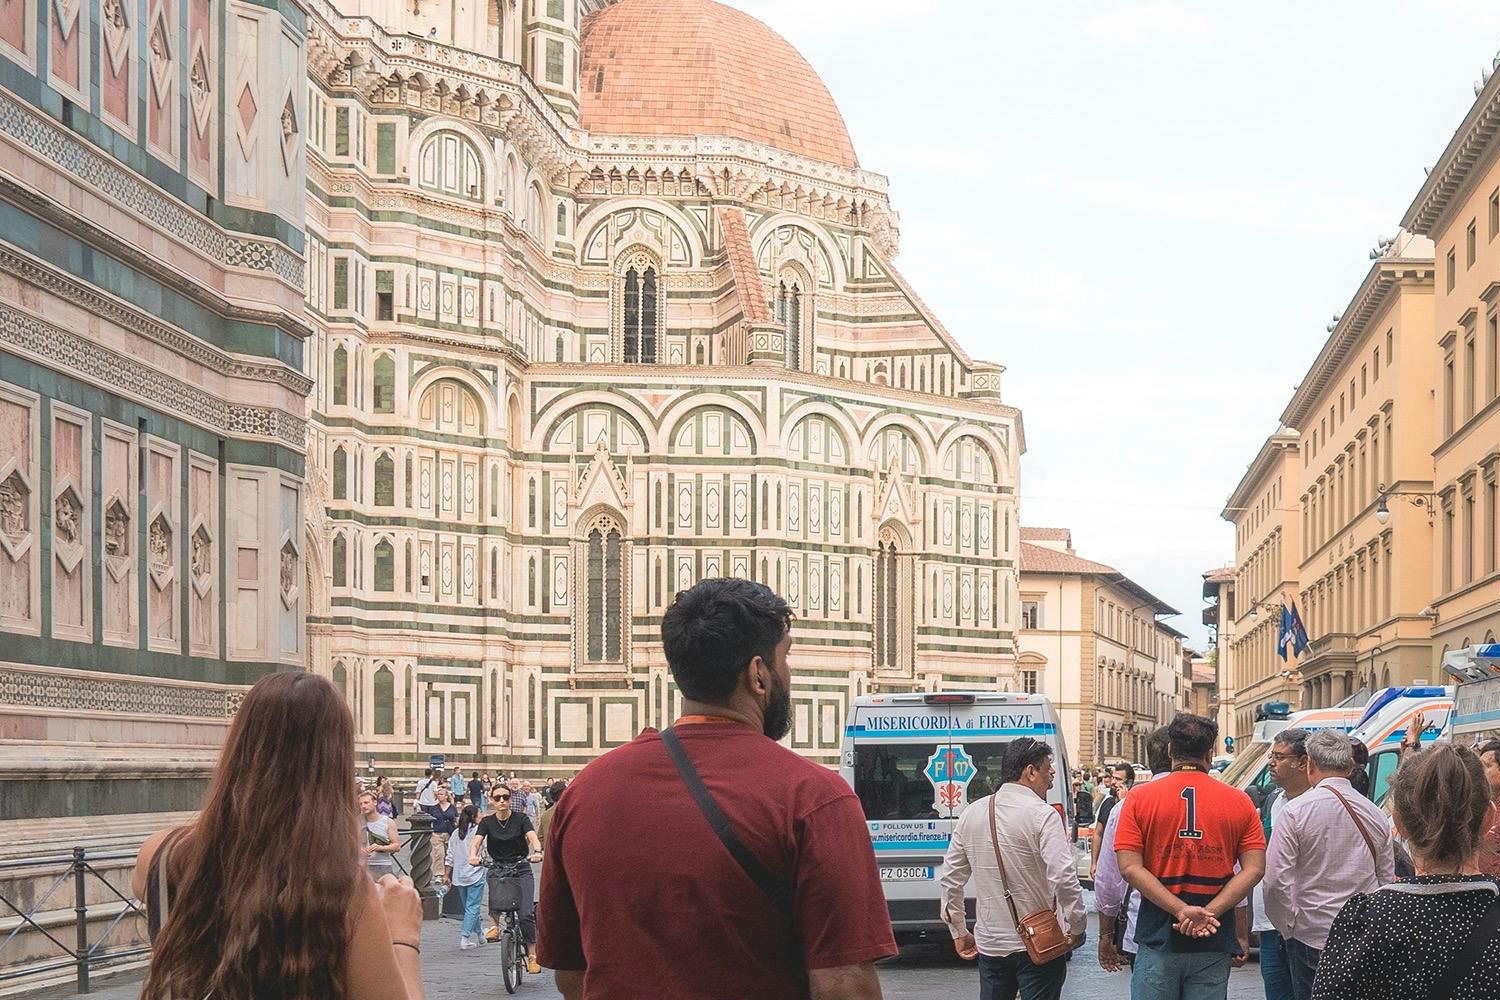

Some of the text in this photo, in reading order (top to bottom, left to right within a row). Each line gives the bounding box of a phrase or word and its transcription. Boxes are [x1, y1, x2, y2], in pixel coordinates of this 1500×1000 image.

[867, 714, 1033, 730] MISERICORDIA di FIRENZE
[1178, 786, 1204, 839] 1
